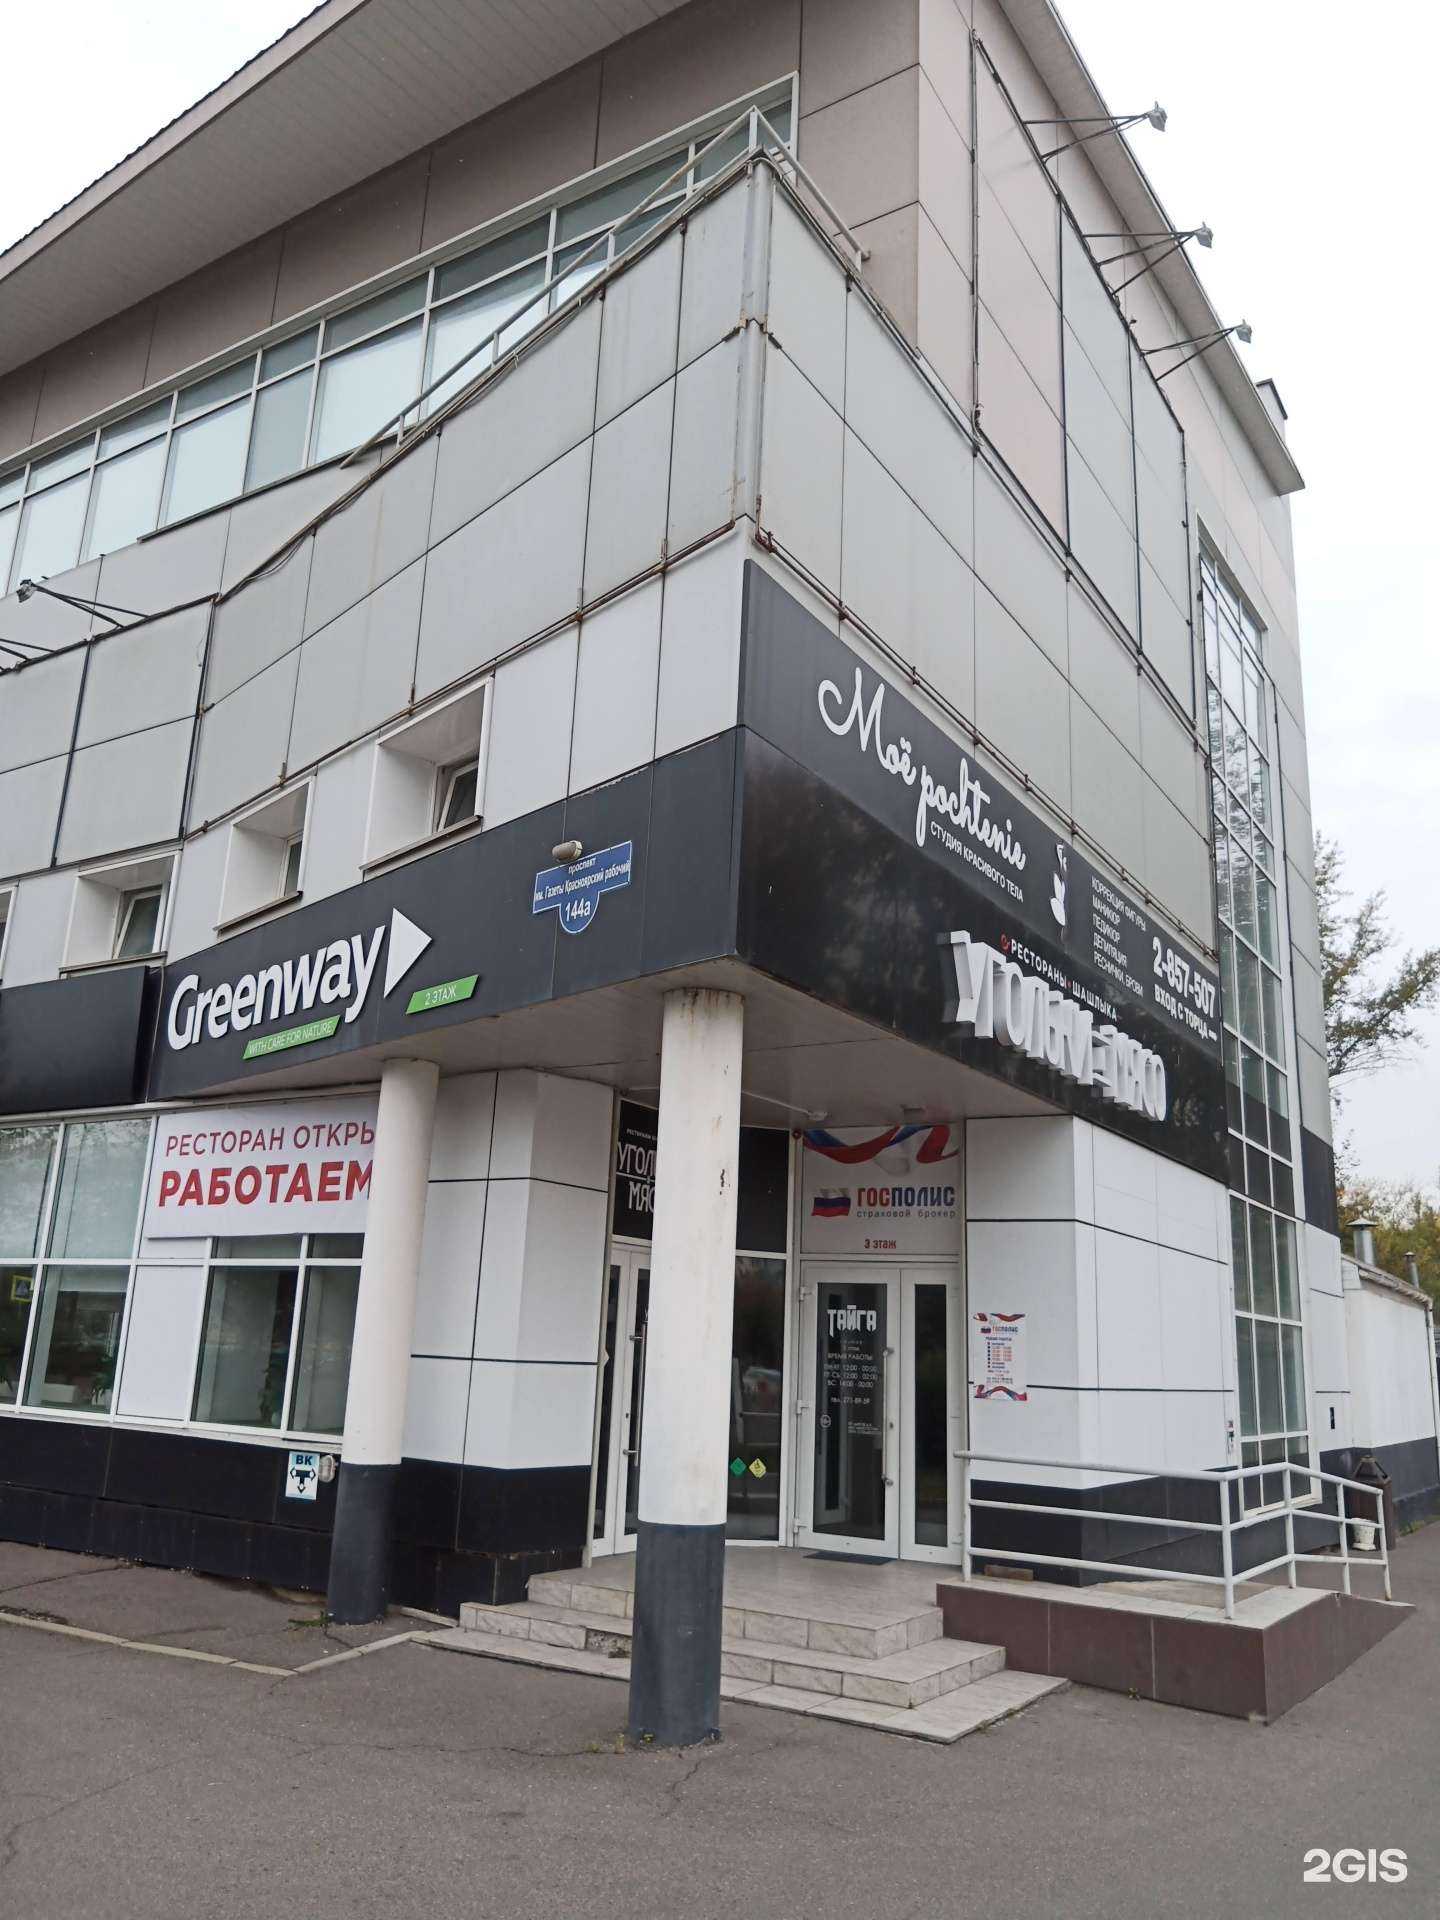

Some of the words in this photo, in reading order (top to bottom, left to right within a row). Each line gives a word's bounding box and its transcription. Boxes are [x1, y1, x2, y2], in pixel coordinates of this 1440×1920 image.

[568, 857, 597, 876] проспект
[930, 820, 963, 855] СТУДИЯ
[963, 848, 1006, 890] КРАСИВОГО
[1006, 878, 1025, 904] ТЕЛА
[545, 883, 564, 900] Газеты
[564, 868, 604, 895] Красноярский
[604, 859, 632, 883] рабочий
[565, 897, 591, 922] 144а
[1092, 913, 1121, 944] ПЕДИКЮР
[168, 925, 387, 1051] Greenway
[1010, 937, 1067, 989] РЕСТОРАНЫ
[1072, 979, 1118, 1022] ШАШЛЫКА
[1152, 936, 1216, 1019] 2-857-507
[431, 985, 457, 1004] ЭТАЖ
[1154, 983, 1178, 1020] ВХОД
[1177, 1002, 1185, 1021] С
[1184, 1007, 1209, 1040] ТОРЦА
[249, 1039, 267, 1055] WITH
[267, 1034, 286, 1051] CARE
[286, 1029, 302, 1046] FOR
[302, 1021, 334, 1042] NATURE
[166, 1127, 285, 1157] РЕСТОРАН
[158, 1159, 374, 1207] РАБОТАЕМ
[857, 1186, 956, 1208] ГОСПОЛИС
[856, 1208, 911, 1218] страховой
[917, 1209, 956, 1218] брокер
[863, 1238, 870, 1249] 3
[872, 1240, 897, 1249] этаж
[827, 1305, 877, 1338] ТАЙГА
